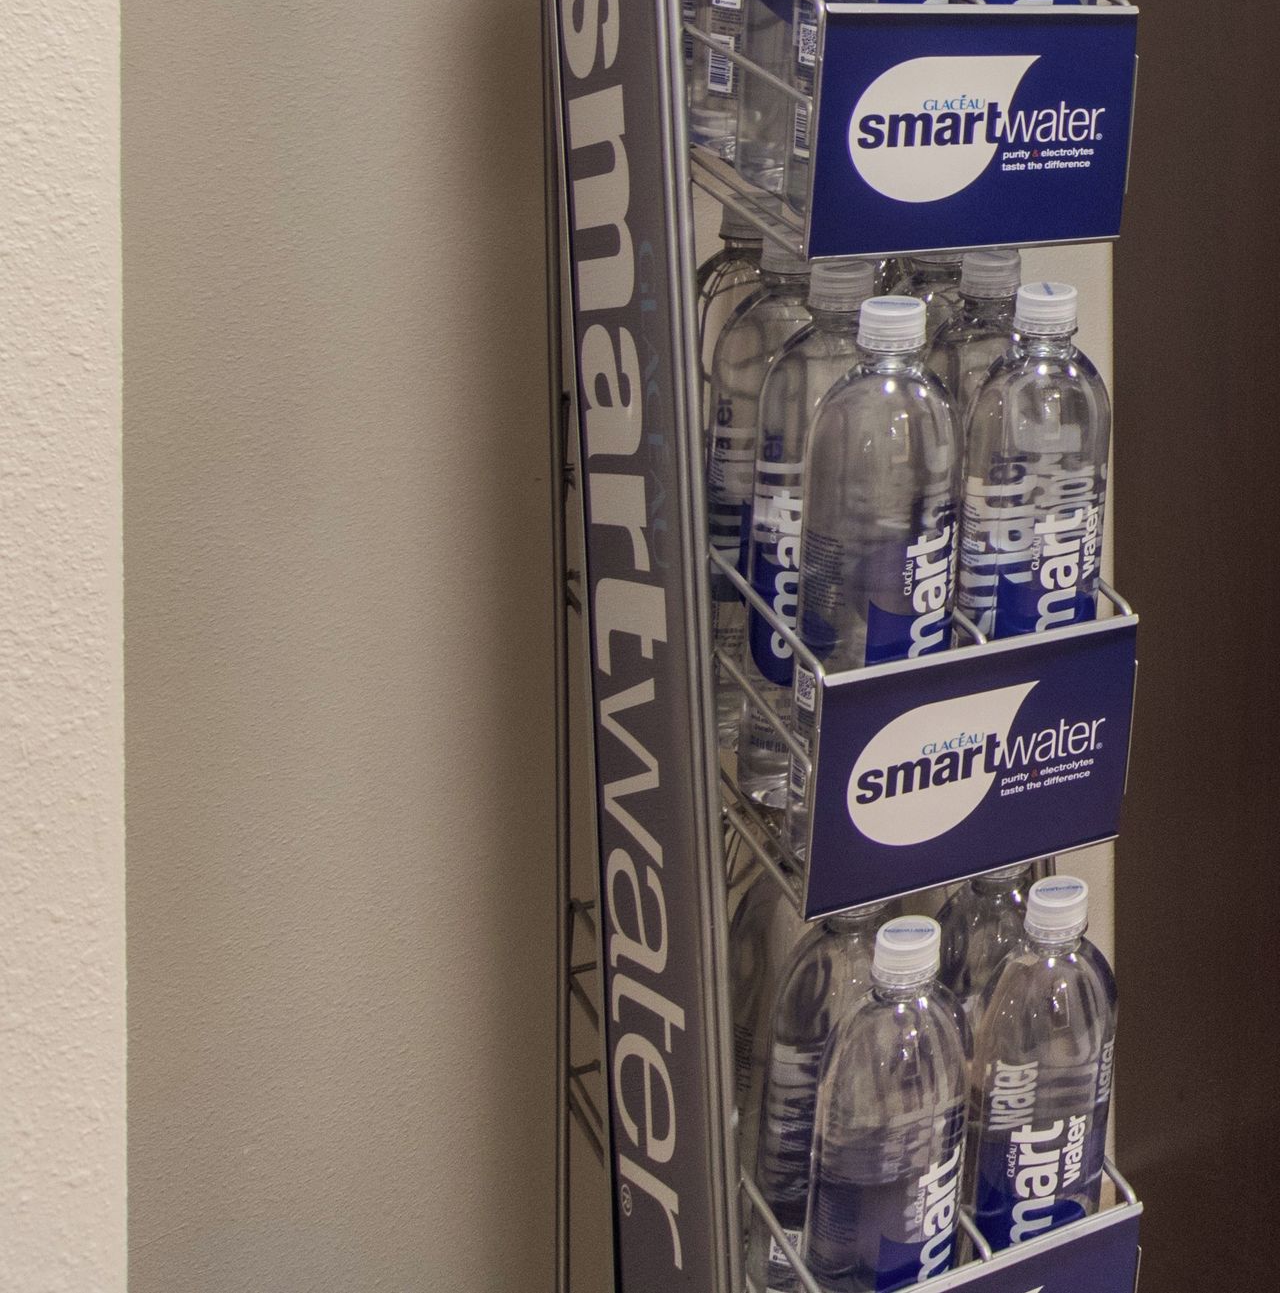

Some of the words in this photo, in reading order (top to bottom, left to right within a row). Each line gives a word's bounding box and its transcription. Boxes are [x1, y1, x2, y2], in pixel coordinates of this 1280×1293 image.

[923, 95, 986, 112] GLACÉAU
[1002, 148, 1031, 161] purity
[1031, 149, 1040, 158] &
[1040, 146, 1095, 159] electrolytes
[1002, 161, 1026, 172] taste
[1027, 160, 1042, 171] the
[1044, 159, 1091, 170] difference
[1082, 505, 1099, 579] water
[903, 559, 914, 596] GLACÉAU
[907, 525, 951, 659] mart
[921, 732, 986, 757] GLACÉAU
[1000, 782, 1025, 797] taste
[1026, 779, 1042, 791] the
[1043, 769, 1091, 788] difference
[1001, 771, 1029, 787] purity
[1031, 769, 1039, 778] &
[1040, 758, 1095, 777] electrolytes
[1062, 1114, 1087, 1189] water
